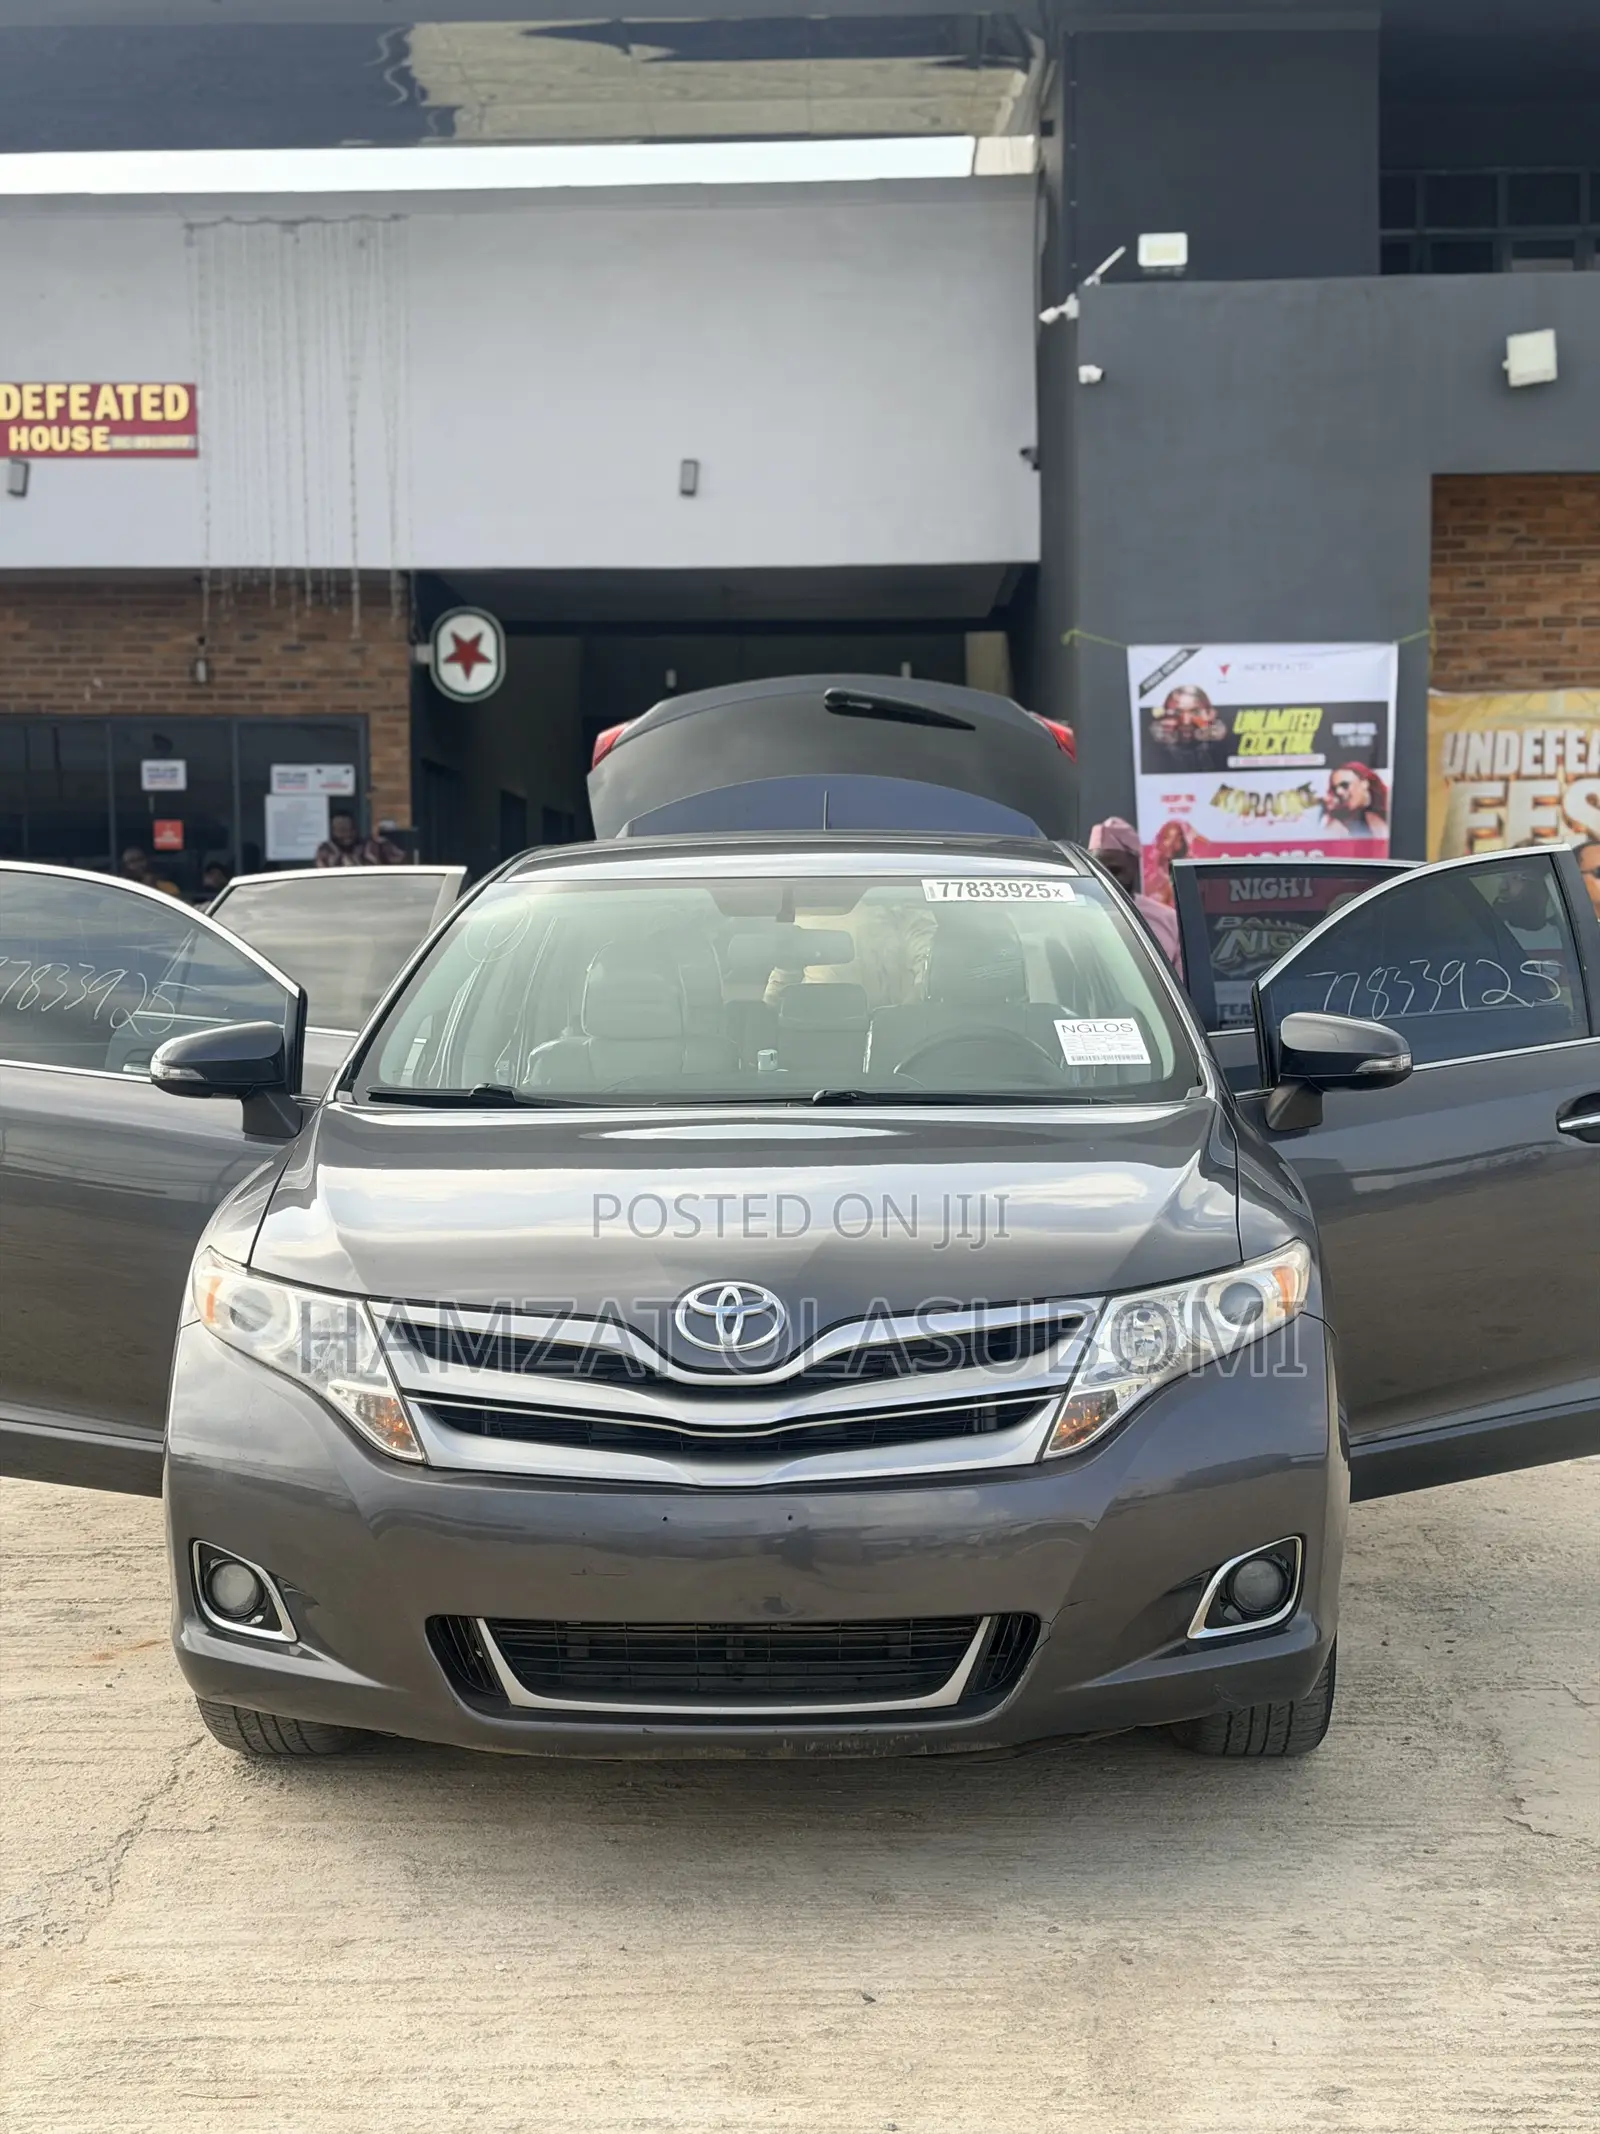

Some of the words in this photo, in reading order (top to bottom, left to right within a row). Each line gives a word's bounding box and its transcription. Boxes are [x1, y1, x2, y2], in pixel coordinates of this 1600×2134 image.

[8, 426, 110, 451] HOUSE
[1230, 877, 1314, 902] NIGHT
[0, 956, 201, 1036] 7833925
[1061, 1023, 1134, 1033] NGLOS
